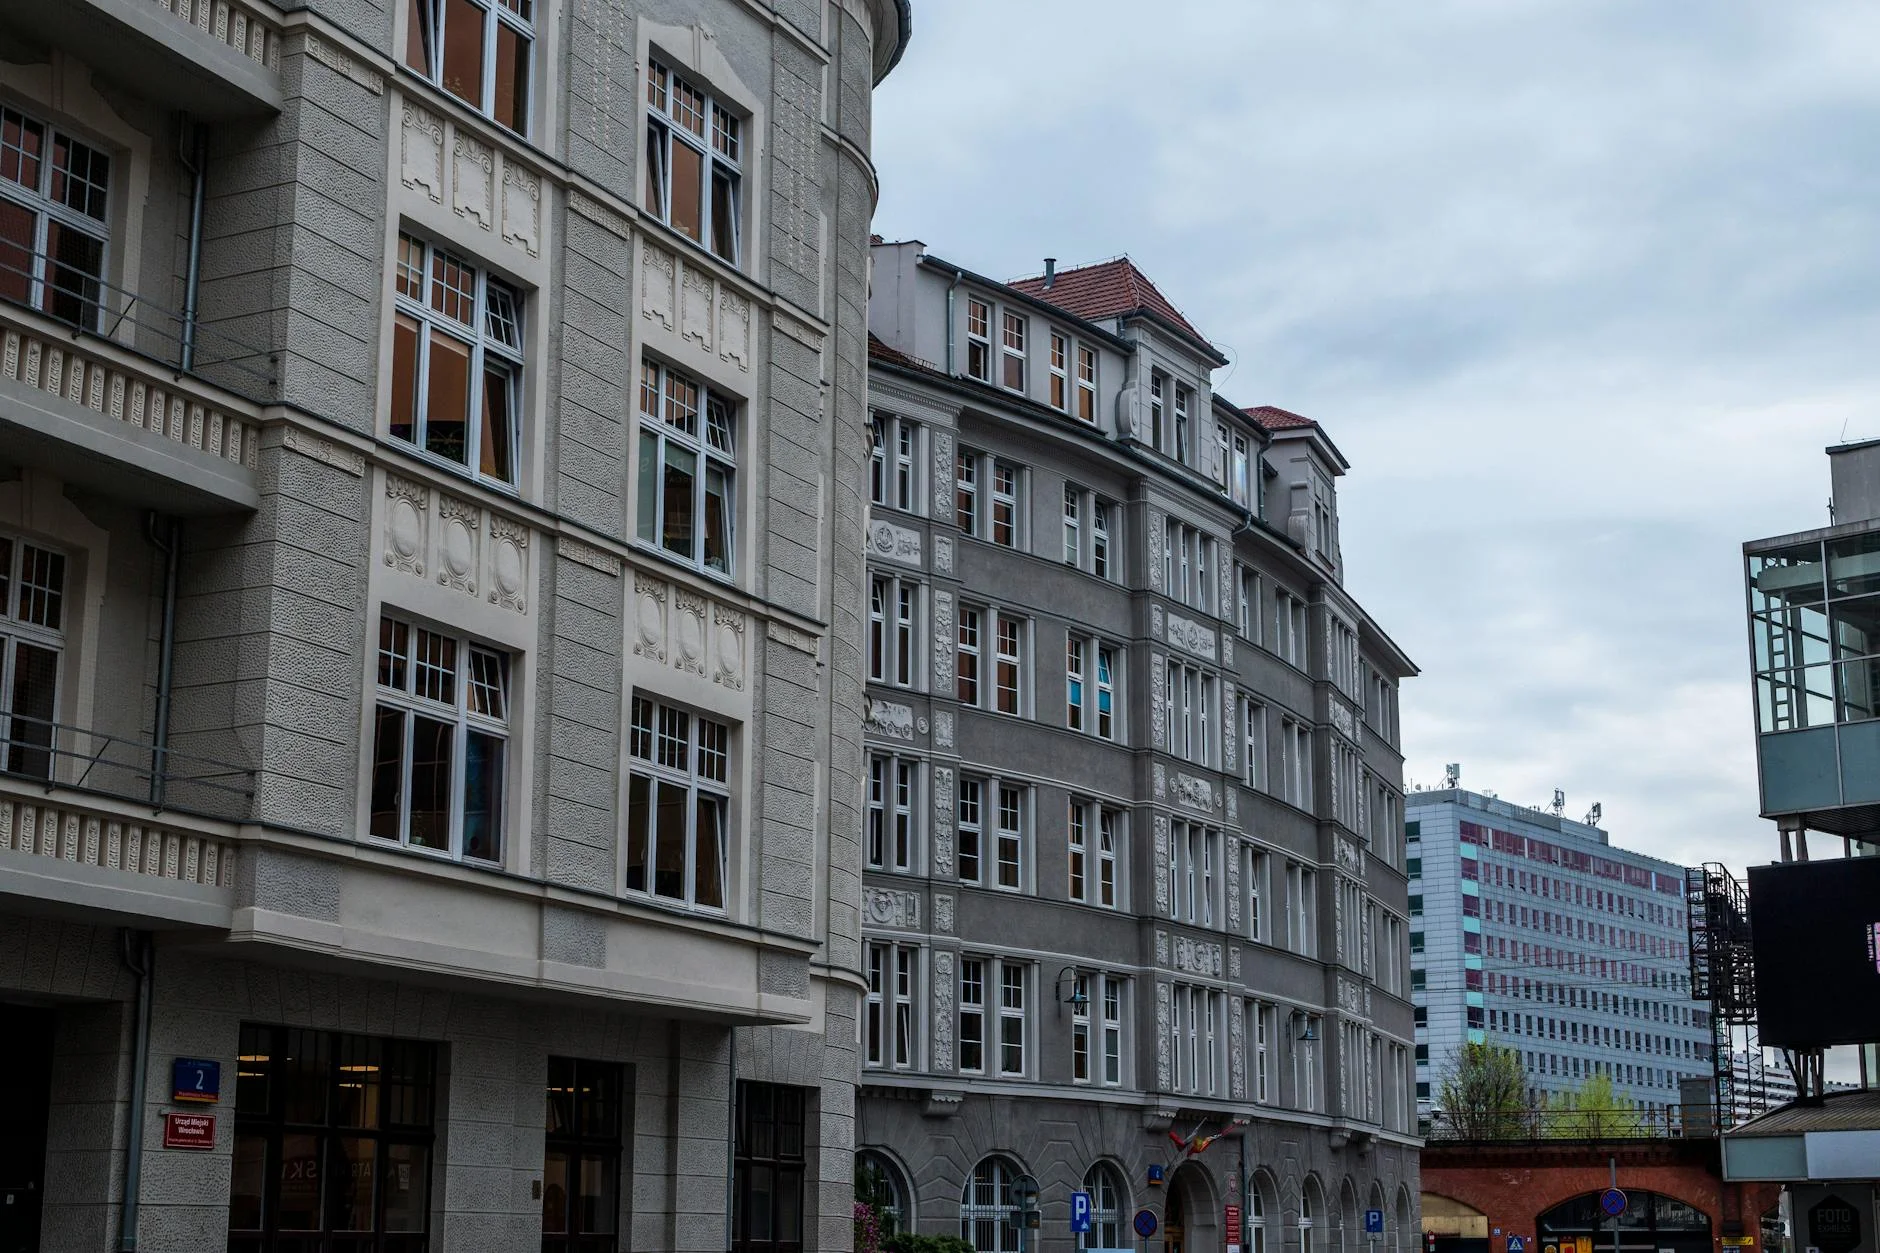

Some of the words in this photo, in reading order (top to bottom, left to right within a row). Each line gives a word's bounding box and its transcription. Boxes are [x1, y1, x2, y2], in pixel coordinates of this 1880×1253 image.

[195, 1069, 204, 1090] 2
[1075, 1195, 1087, 1221] P
[1816, 1208, 1851, 1223] FOTO
[1369, 1211, 1379, 1226] P
